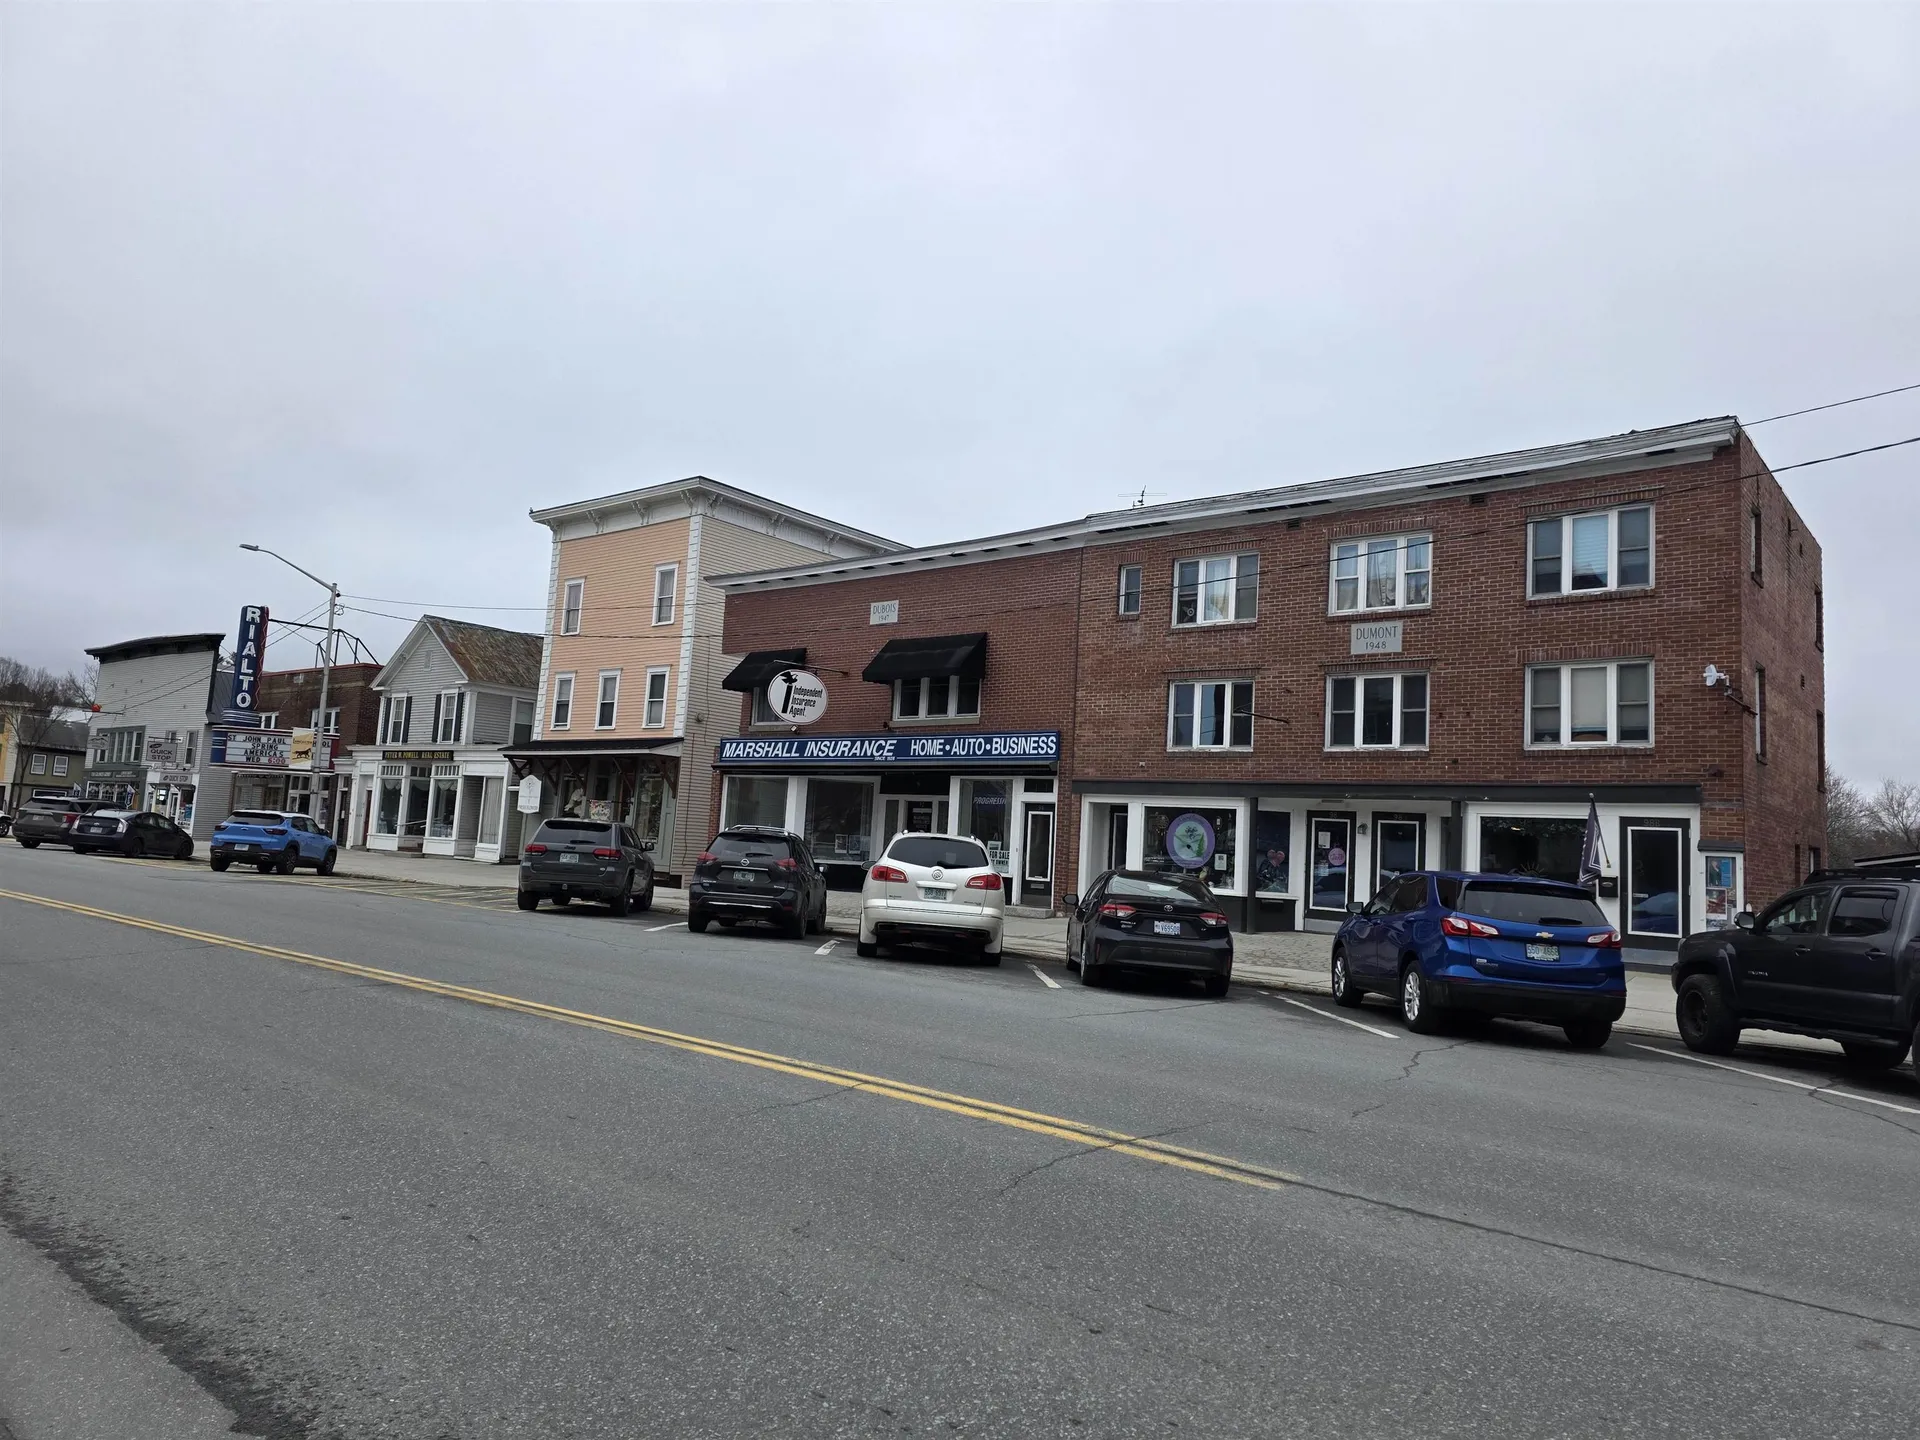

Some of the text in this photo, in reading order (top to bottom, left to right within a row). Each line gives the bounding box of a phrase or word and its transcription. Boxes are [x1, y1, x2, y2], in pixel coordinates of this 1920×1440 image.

[873, 603, 896, 615] DUBOIS
[1356, 625, 1398, 640] DUMONT
[1365, 641, 1387, 650] 1948
[236, 606, 261, 708] RIALTO
[793, 685, 823, 699] Independent
[791, 695, 816, 707] Insurance
[789, 705, 806, 718] Agent
[227, 734, 236, 742] ST
[266, 737, 287, 745] PAUL
[150, 748, 173, 756] QUICK
[251, 743, 279, 751] SPRING
[722, 741, 800, 758] MARSHALL
[803, 739, 897, 757] INSURANCE
[989, 850, 1010, 860] FOR SALE
